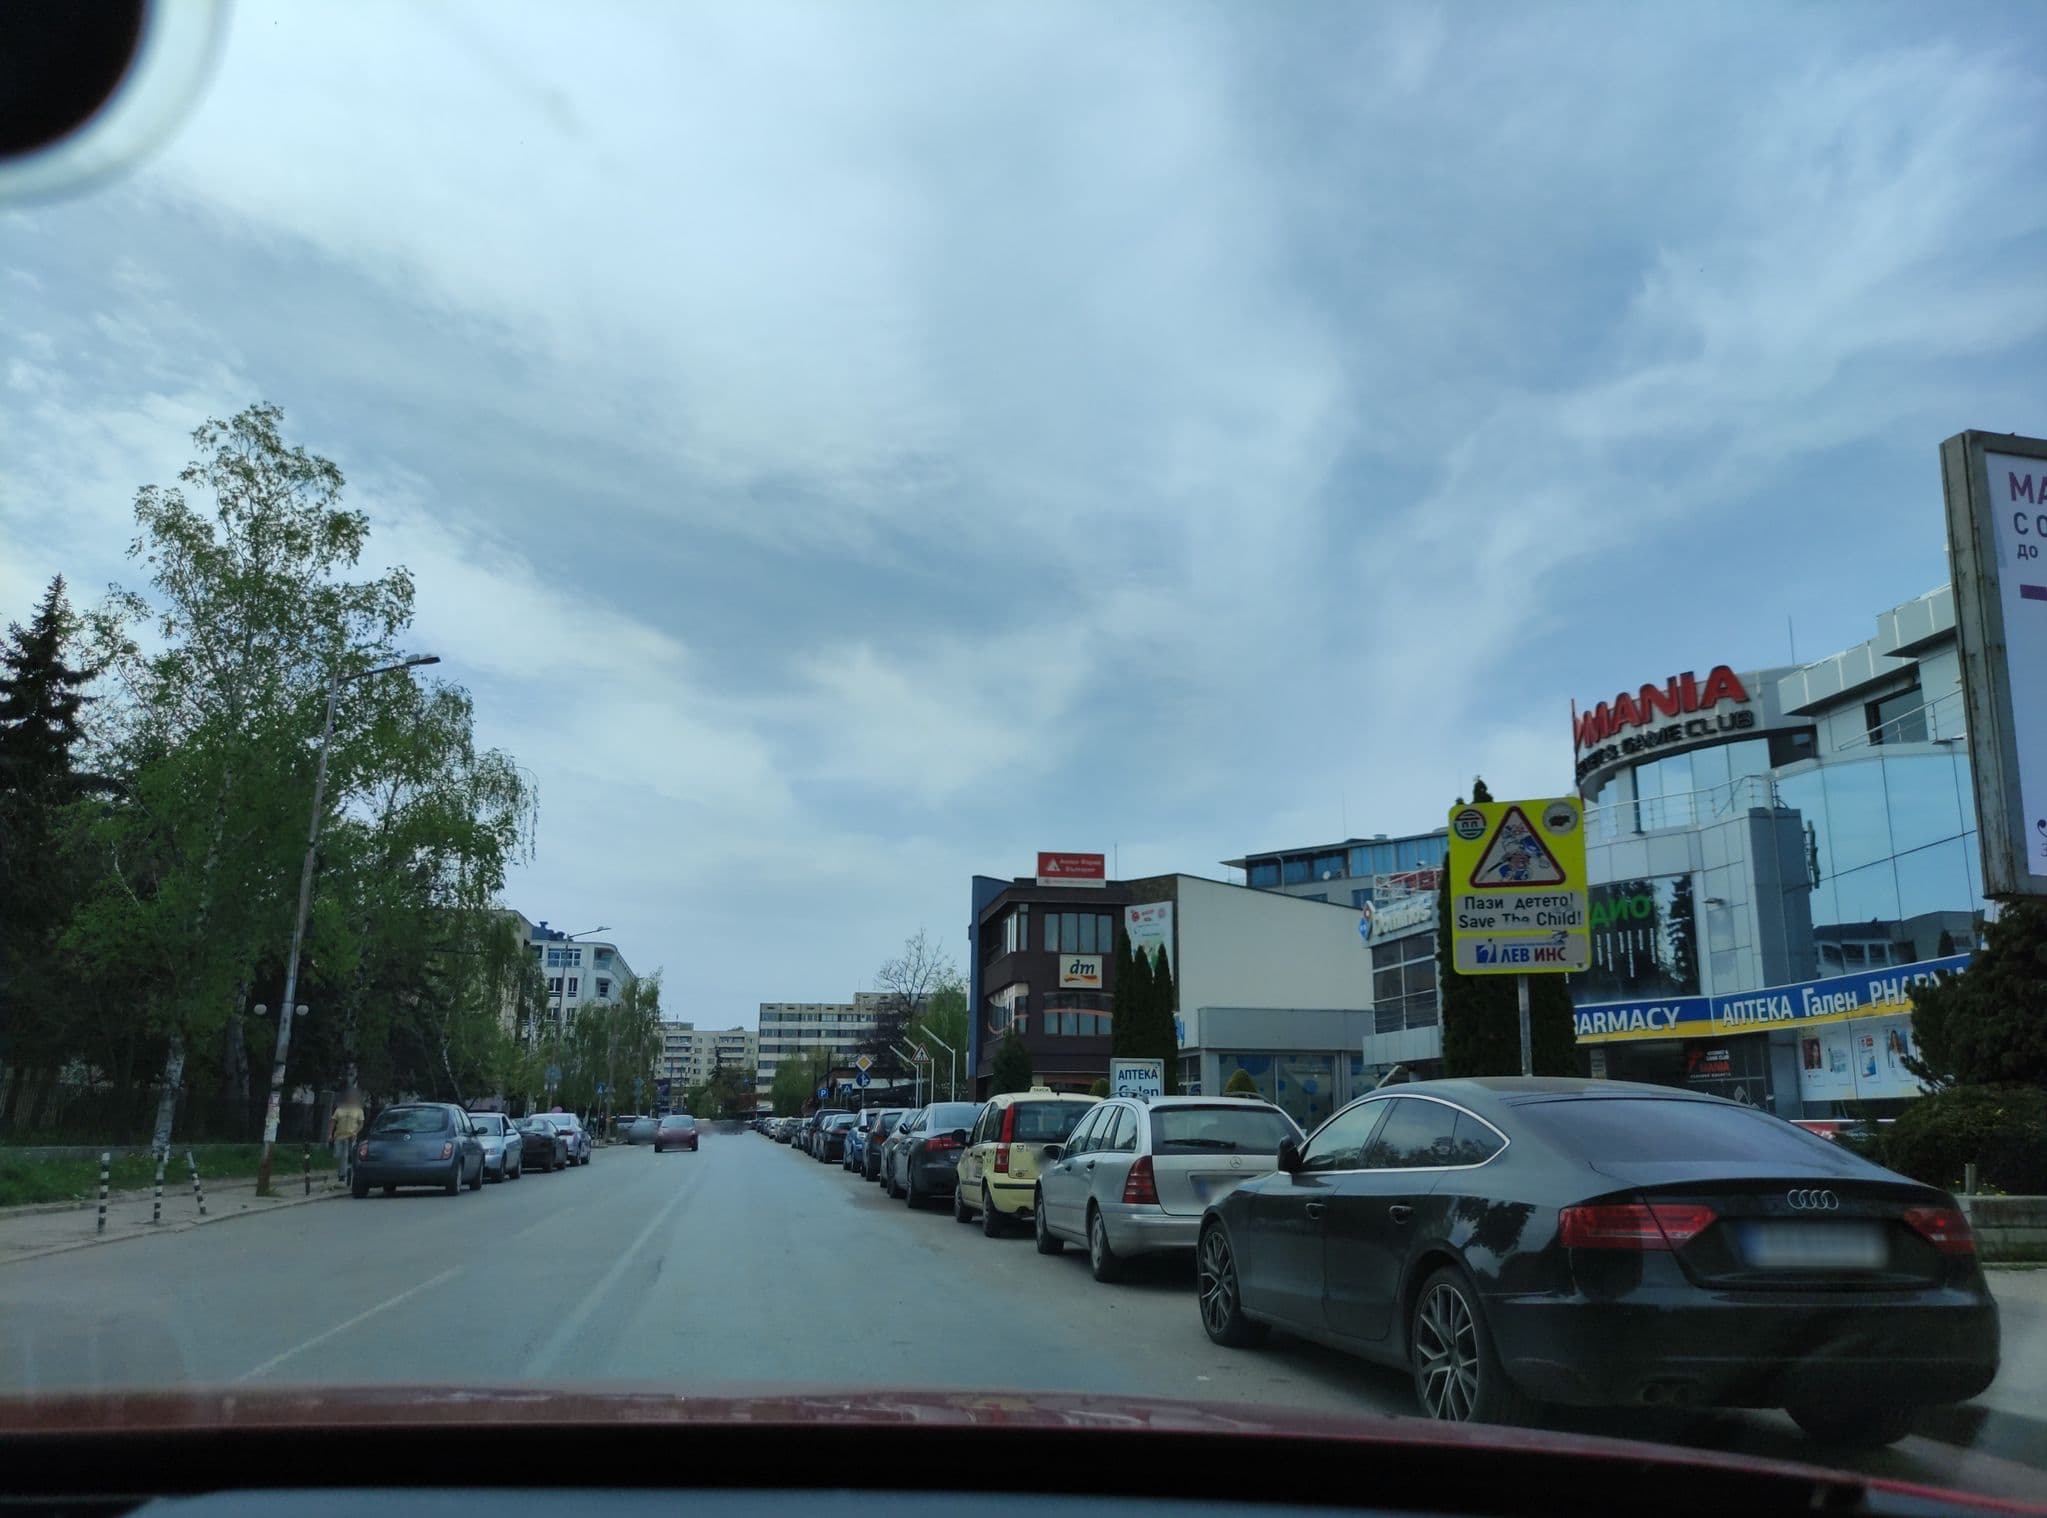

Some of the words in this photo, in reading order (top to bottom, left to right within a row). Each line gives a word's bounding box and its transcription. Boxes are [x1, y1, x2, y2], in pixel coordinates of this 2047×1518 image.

[2016, 544, 2039, 561] до
[1581, 665, 1750, 748] MANIA
[1684, 710, 1756, 738] CLUB
[1464, 896, 1504, 910] Пази
[1514, 892, 1574, 910] детето!
[1458, 914, 1496, 928] Save
[1536, 911, 1582, 926] Child!
[1500, 948, 1530, 963] ЛЕВ
[1534, 946, 1567, 962] ИНС
[1070, 959, 1095, 974] dm
[1721, 995, 1795, 1027] АПТЕКА
[1801, 987, 1859, 1017] Гален
[1118, 1069, 1158, 1080] АПТЕКА
